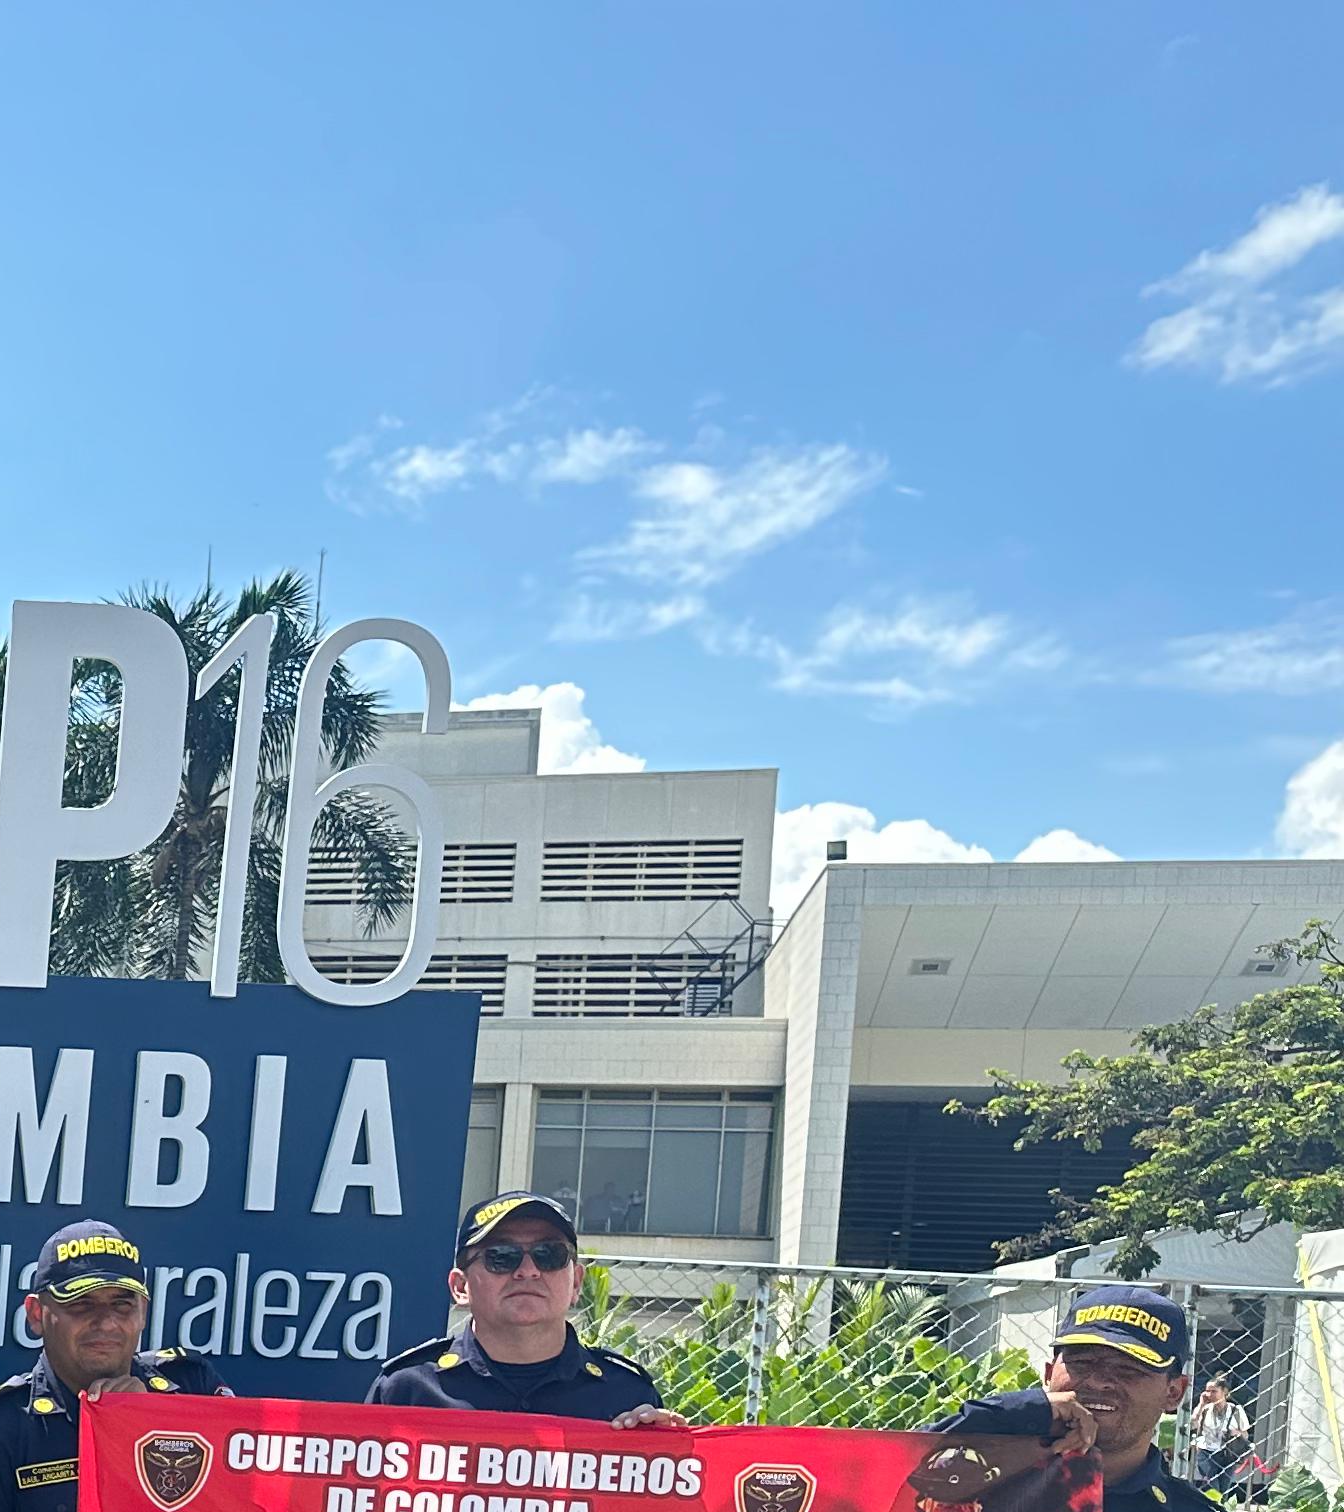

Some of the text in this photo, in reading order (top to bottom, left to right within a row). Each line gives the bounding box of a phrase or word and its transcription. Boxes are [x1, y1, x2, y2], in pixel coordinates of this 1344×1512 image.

[56, 1236, 140, 1264] BOMBEROS
[1074, 1304, 1171, 1342] BOMBEROS
[228, 1432, 702, 1497] CUERPOS DE BOMBEROS
